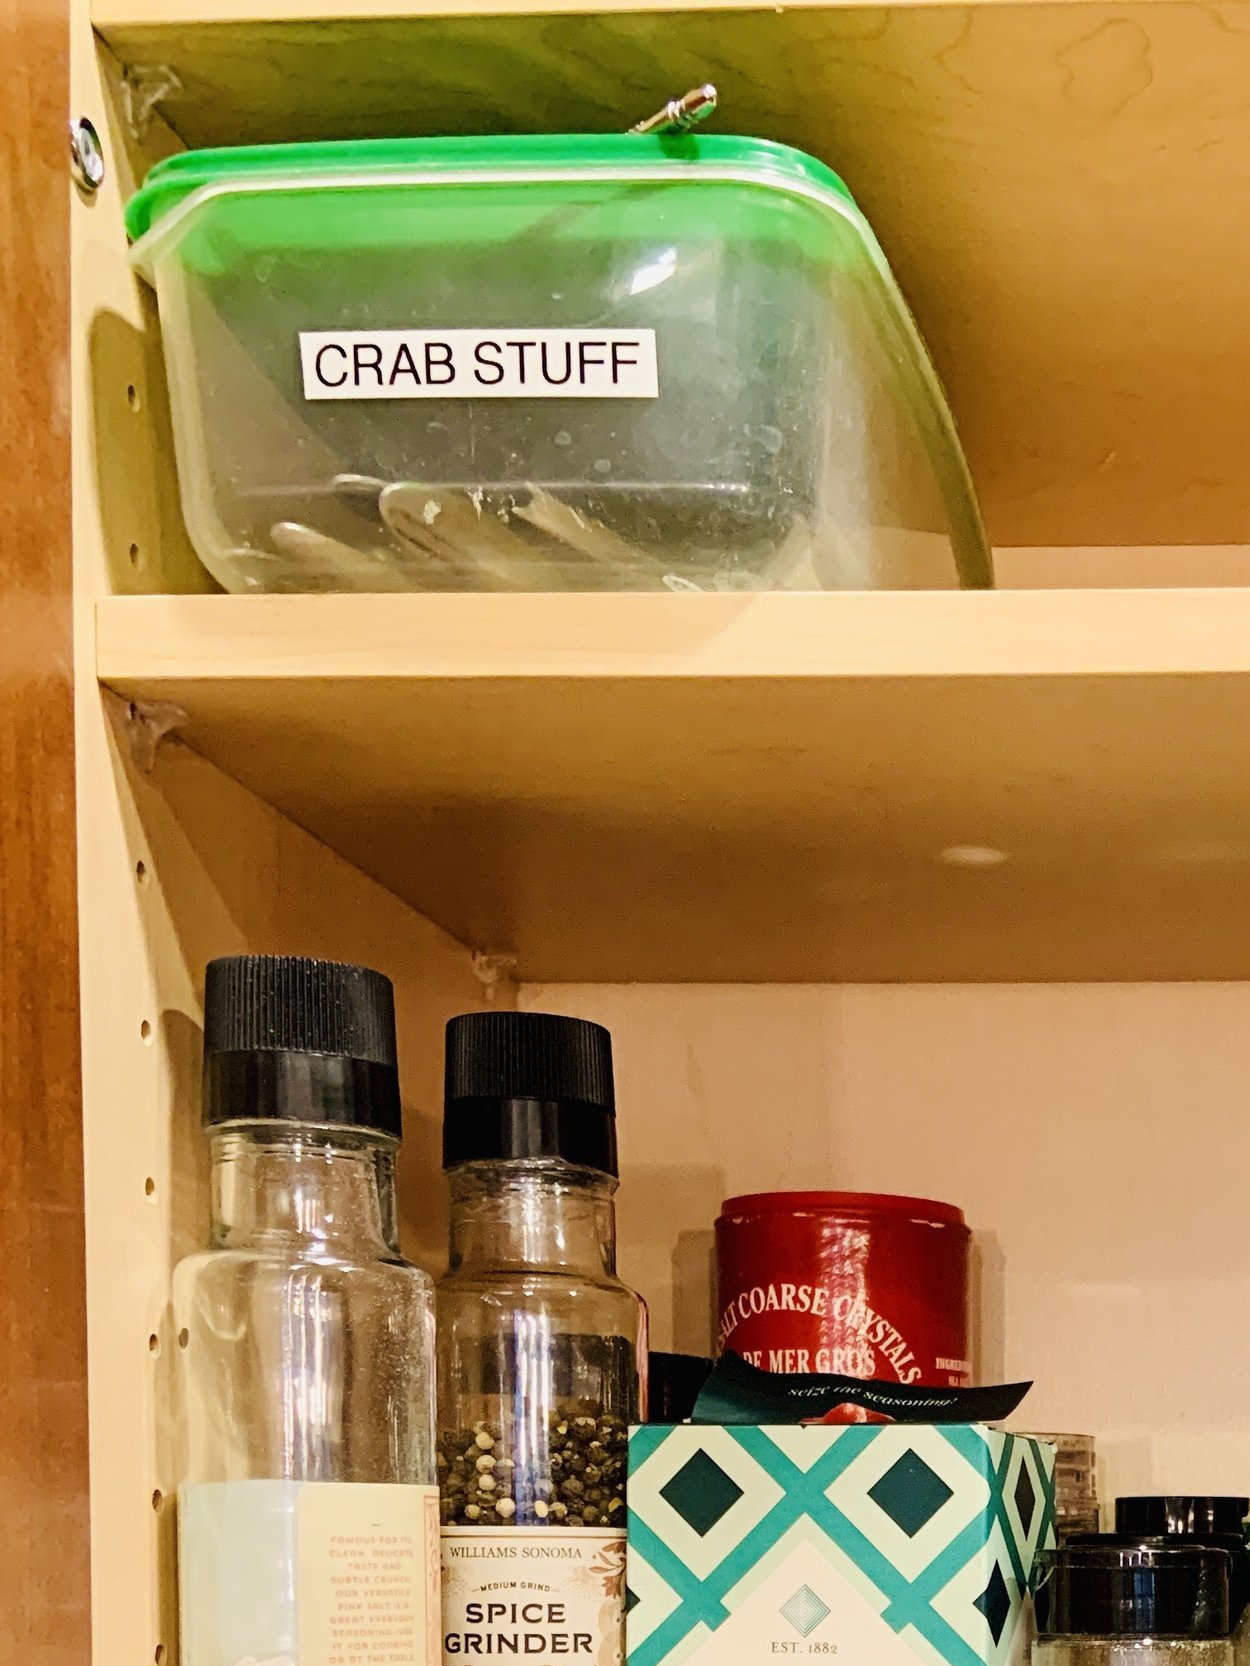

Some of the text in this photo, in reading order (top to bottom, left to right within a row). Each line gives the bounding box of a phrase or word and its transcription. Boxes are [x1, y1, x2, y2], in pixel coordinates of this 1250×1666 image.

[315, 341, 639, 387] CRAB STUFF
[738, 1283, 922, 1385] COARSE CRYSTALS
[769, 1347, 877, 1381] MER GROS
[863, 1390, 958, 1408] seasoning!
[450, 1547, 582, 1559] WILLIAMS SONOMA
[480, 1581, 551, 1593] MEDIUM GRIND
[465, 1603, 567, 1624] SPICE
[444, 1633, 593, 1655] GRINDER
[771, 1642, 838, 1655] EST. 1882
